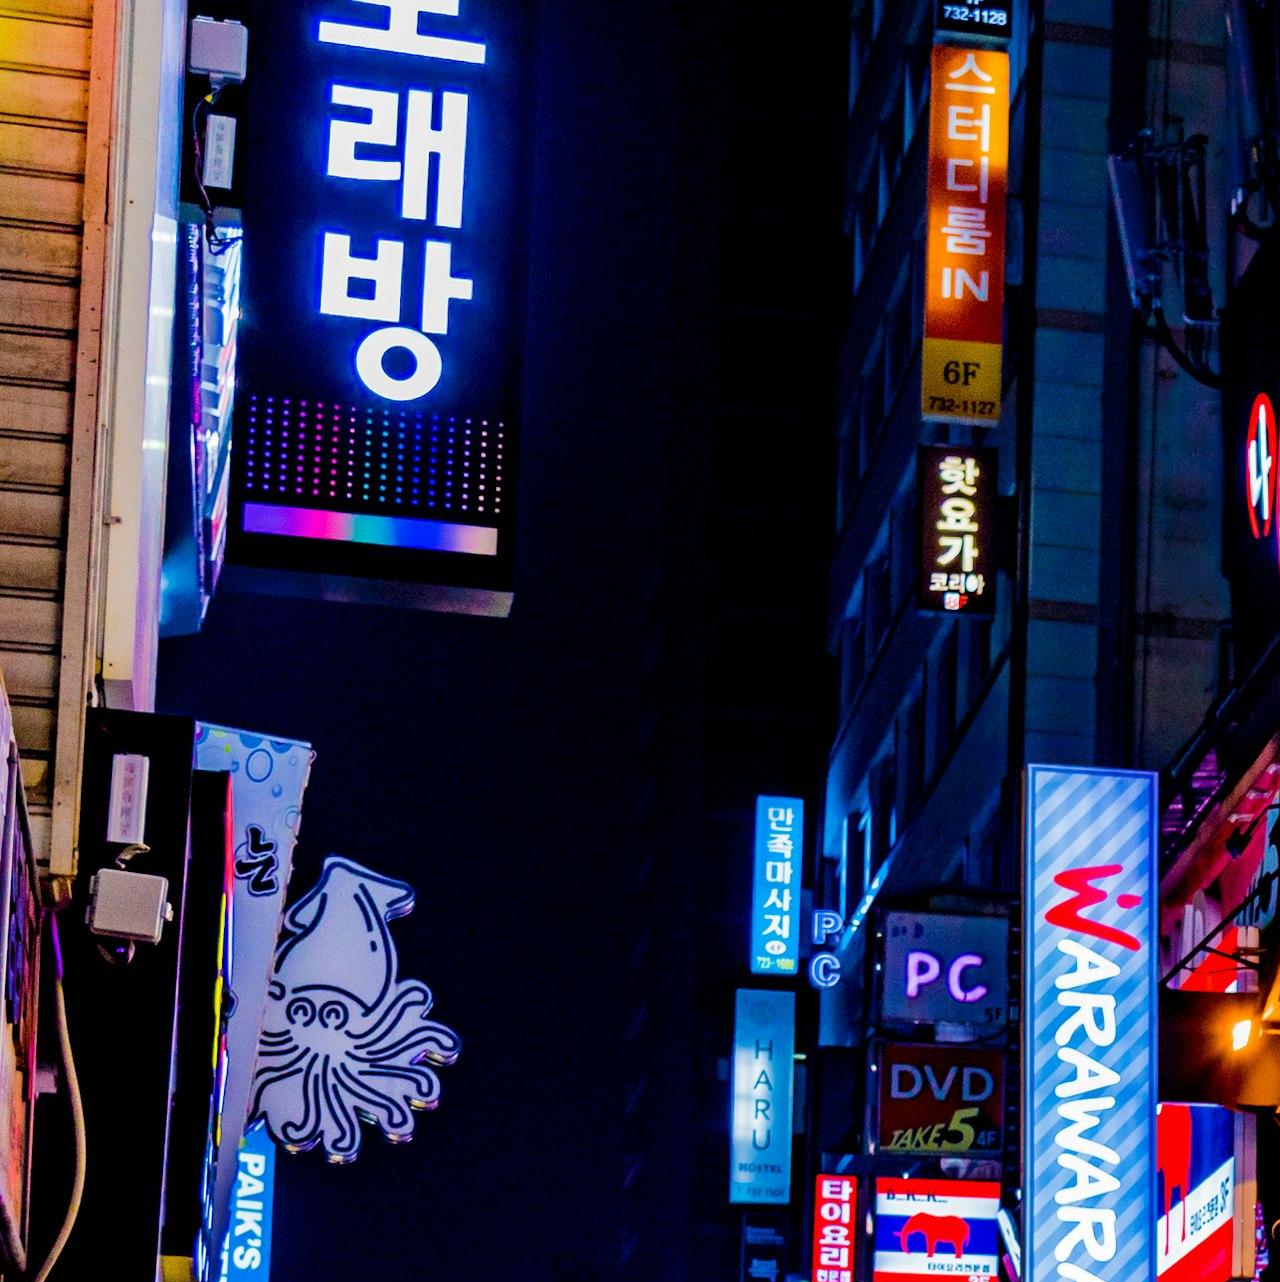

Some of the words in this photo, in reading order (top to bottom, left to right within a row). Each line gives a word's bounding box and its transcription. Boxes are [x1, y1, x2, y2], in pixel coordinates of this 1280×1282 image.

[941, 54, 995, 255] 스터디룸
[942, 267, 988, 302] IN
[943, 360, 981, 386] 6F
[939, 456, 980, 573] 핫요가
[763, 807, 796, 939] 만족마사지
[906, 950, 987, 1002] PC
[753, 1039, 775, 1152] HARU
[891, 1063, 994, 1103] DVD
[233, 1151, 266, 1270] PAIK'S
[818, 1179, 853, 1268] 타이요리
